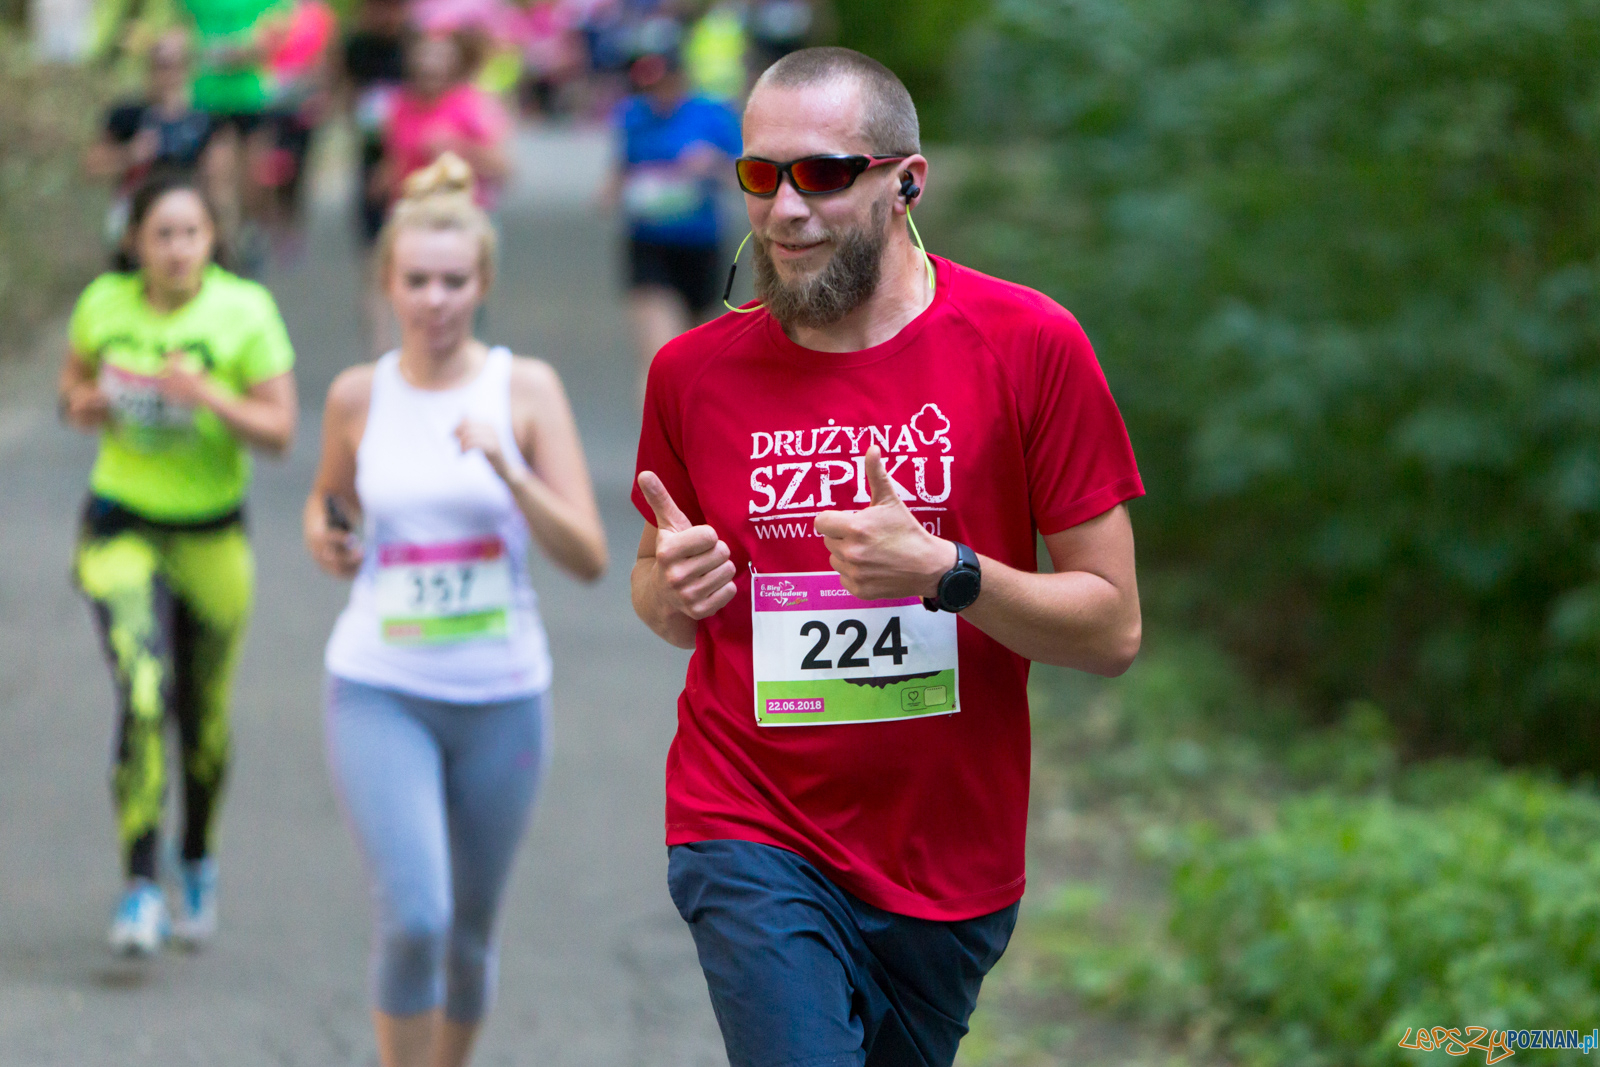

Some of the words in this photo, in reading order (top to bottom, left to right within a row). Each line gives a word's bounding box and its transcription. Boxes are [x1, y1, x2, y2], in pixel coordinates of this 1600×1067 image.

[750, 418, 918, 459] DRUŻYNA
[748, 455, 954, 514] SZPIKU
[799, 616, 908, 670] 224
[768, 700, 822, 711] 22.06.2018
